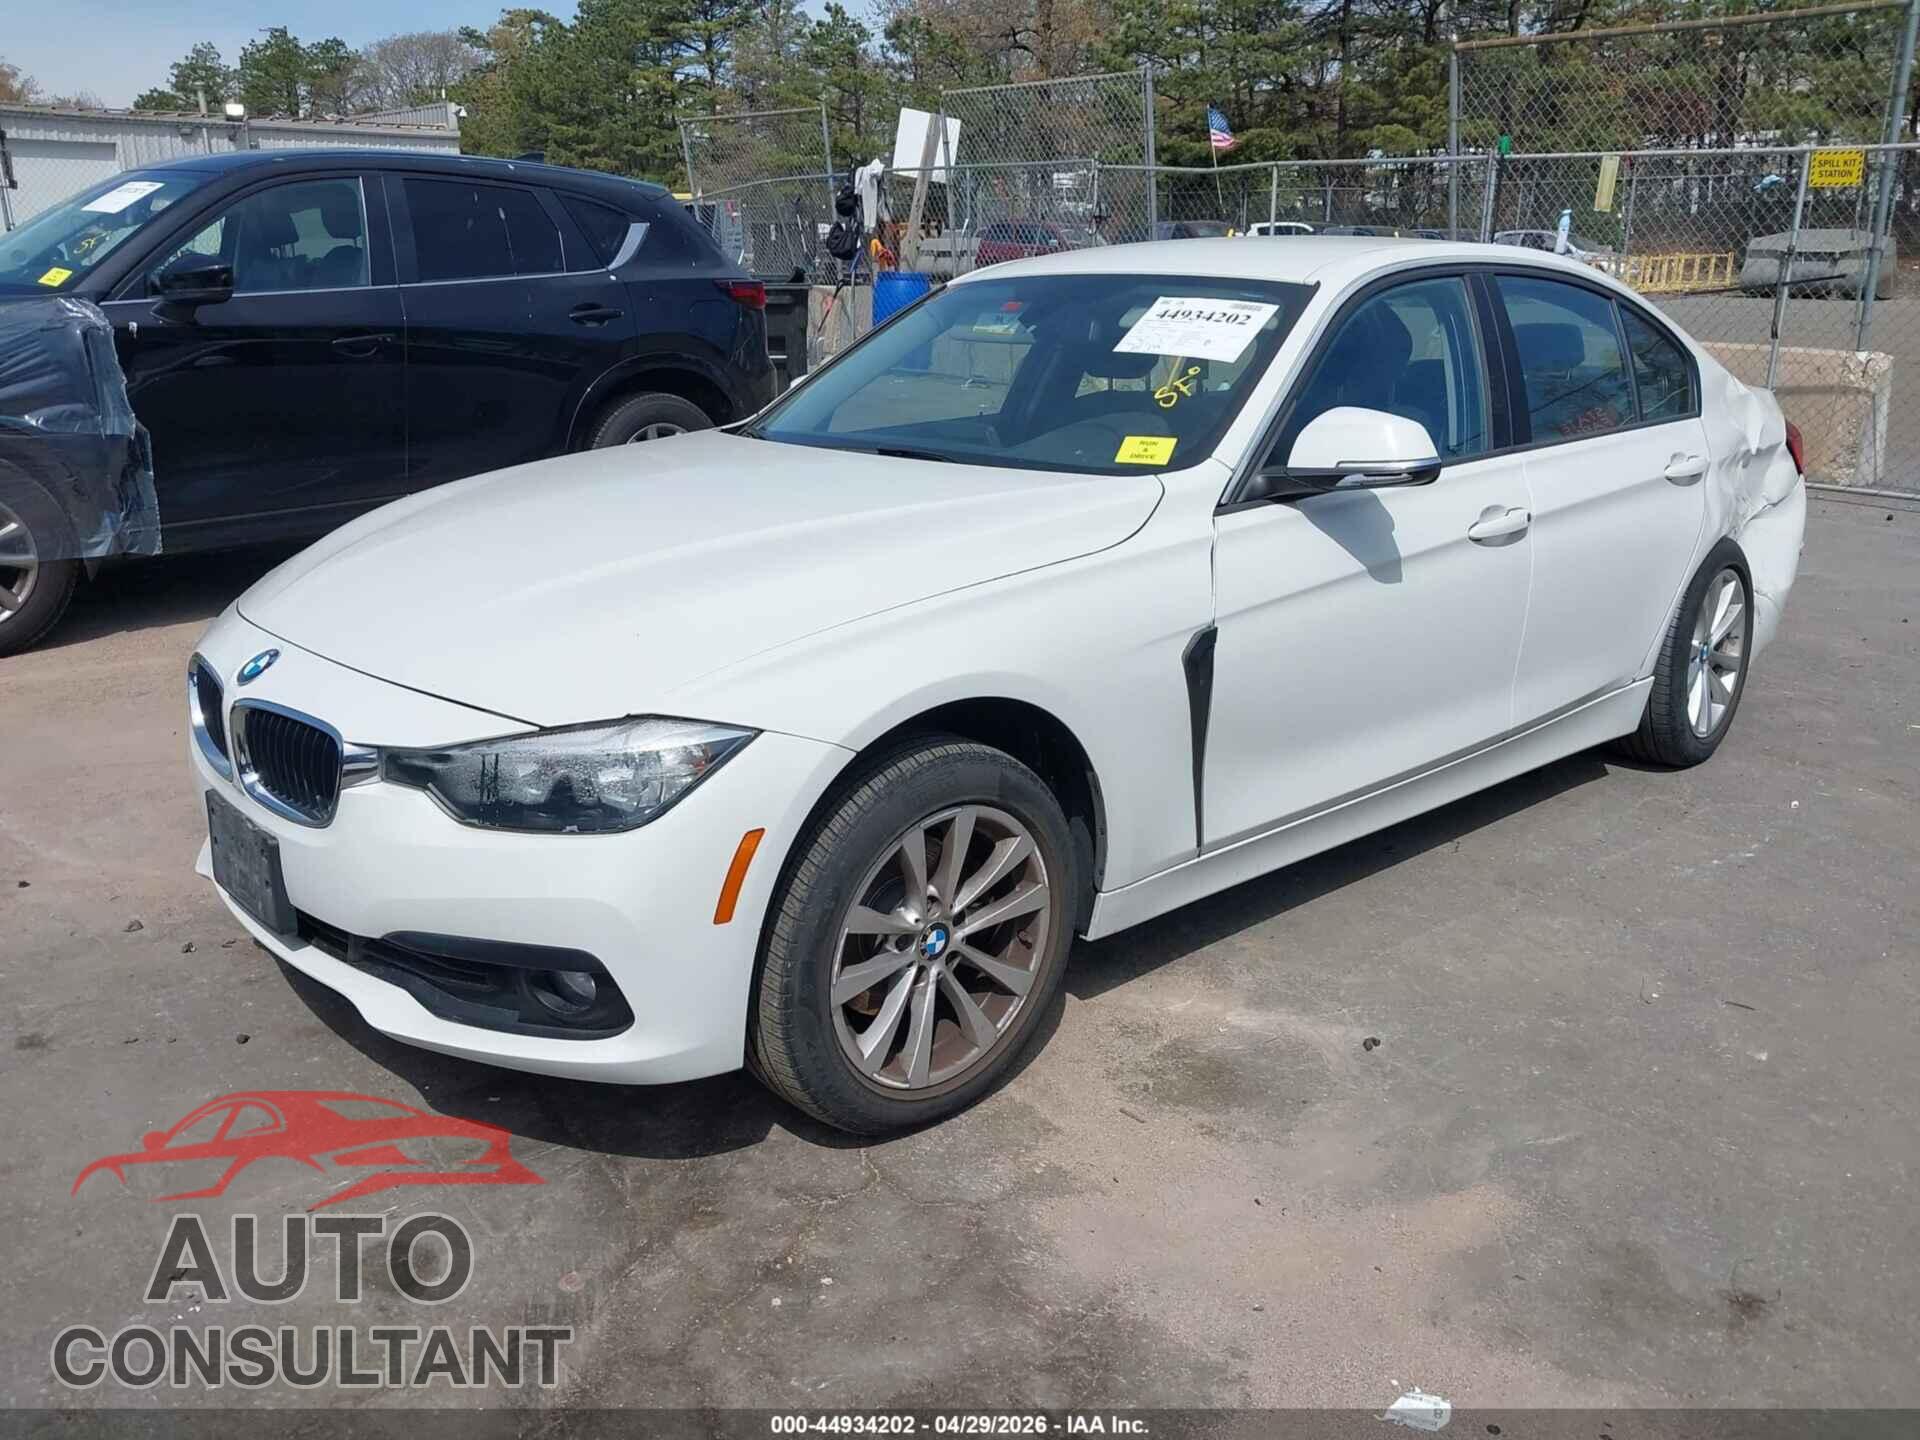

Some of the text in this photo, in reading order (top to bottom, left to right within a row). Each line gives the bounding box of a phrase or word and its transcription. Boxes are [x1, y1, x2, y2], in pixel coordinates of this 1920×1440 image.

[1818, 158, 1857, 167] SPILL KIT
[1818, 169, 1853, 177] STATION
[1156, 308, 1252, 325] 44934202
